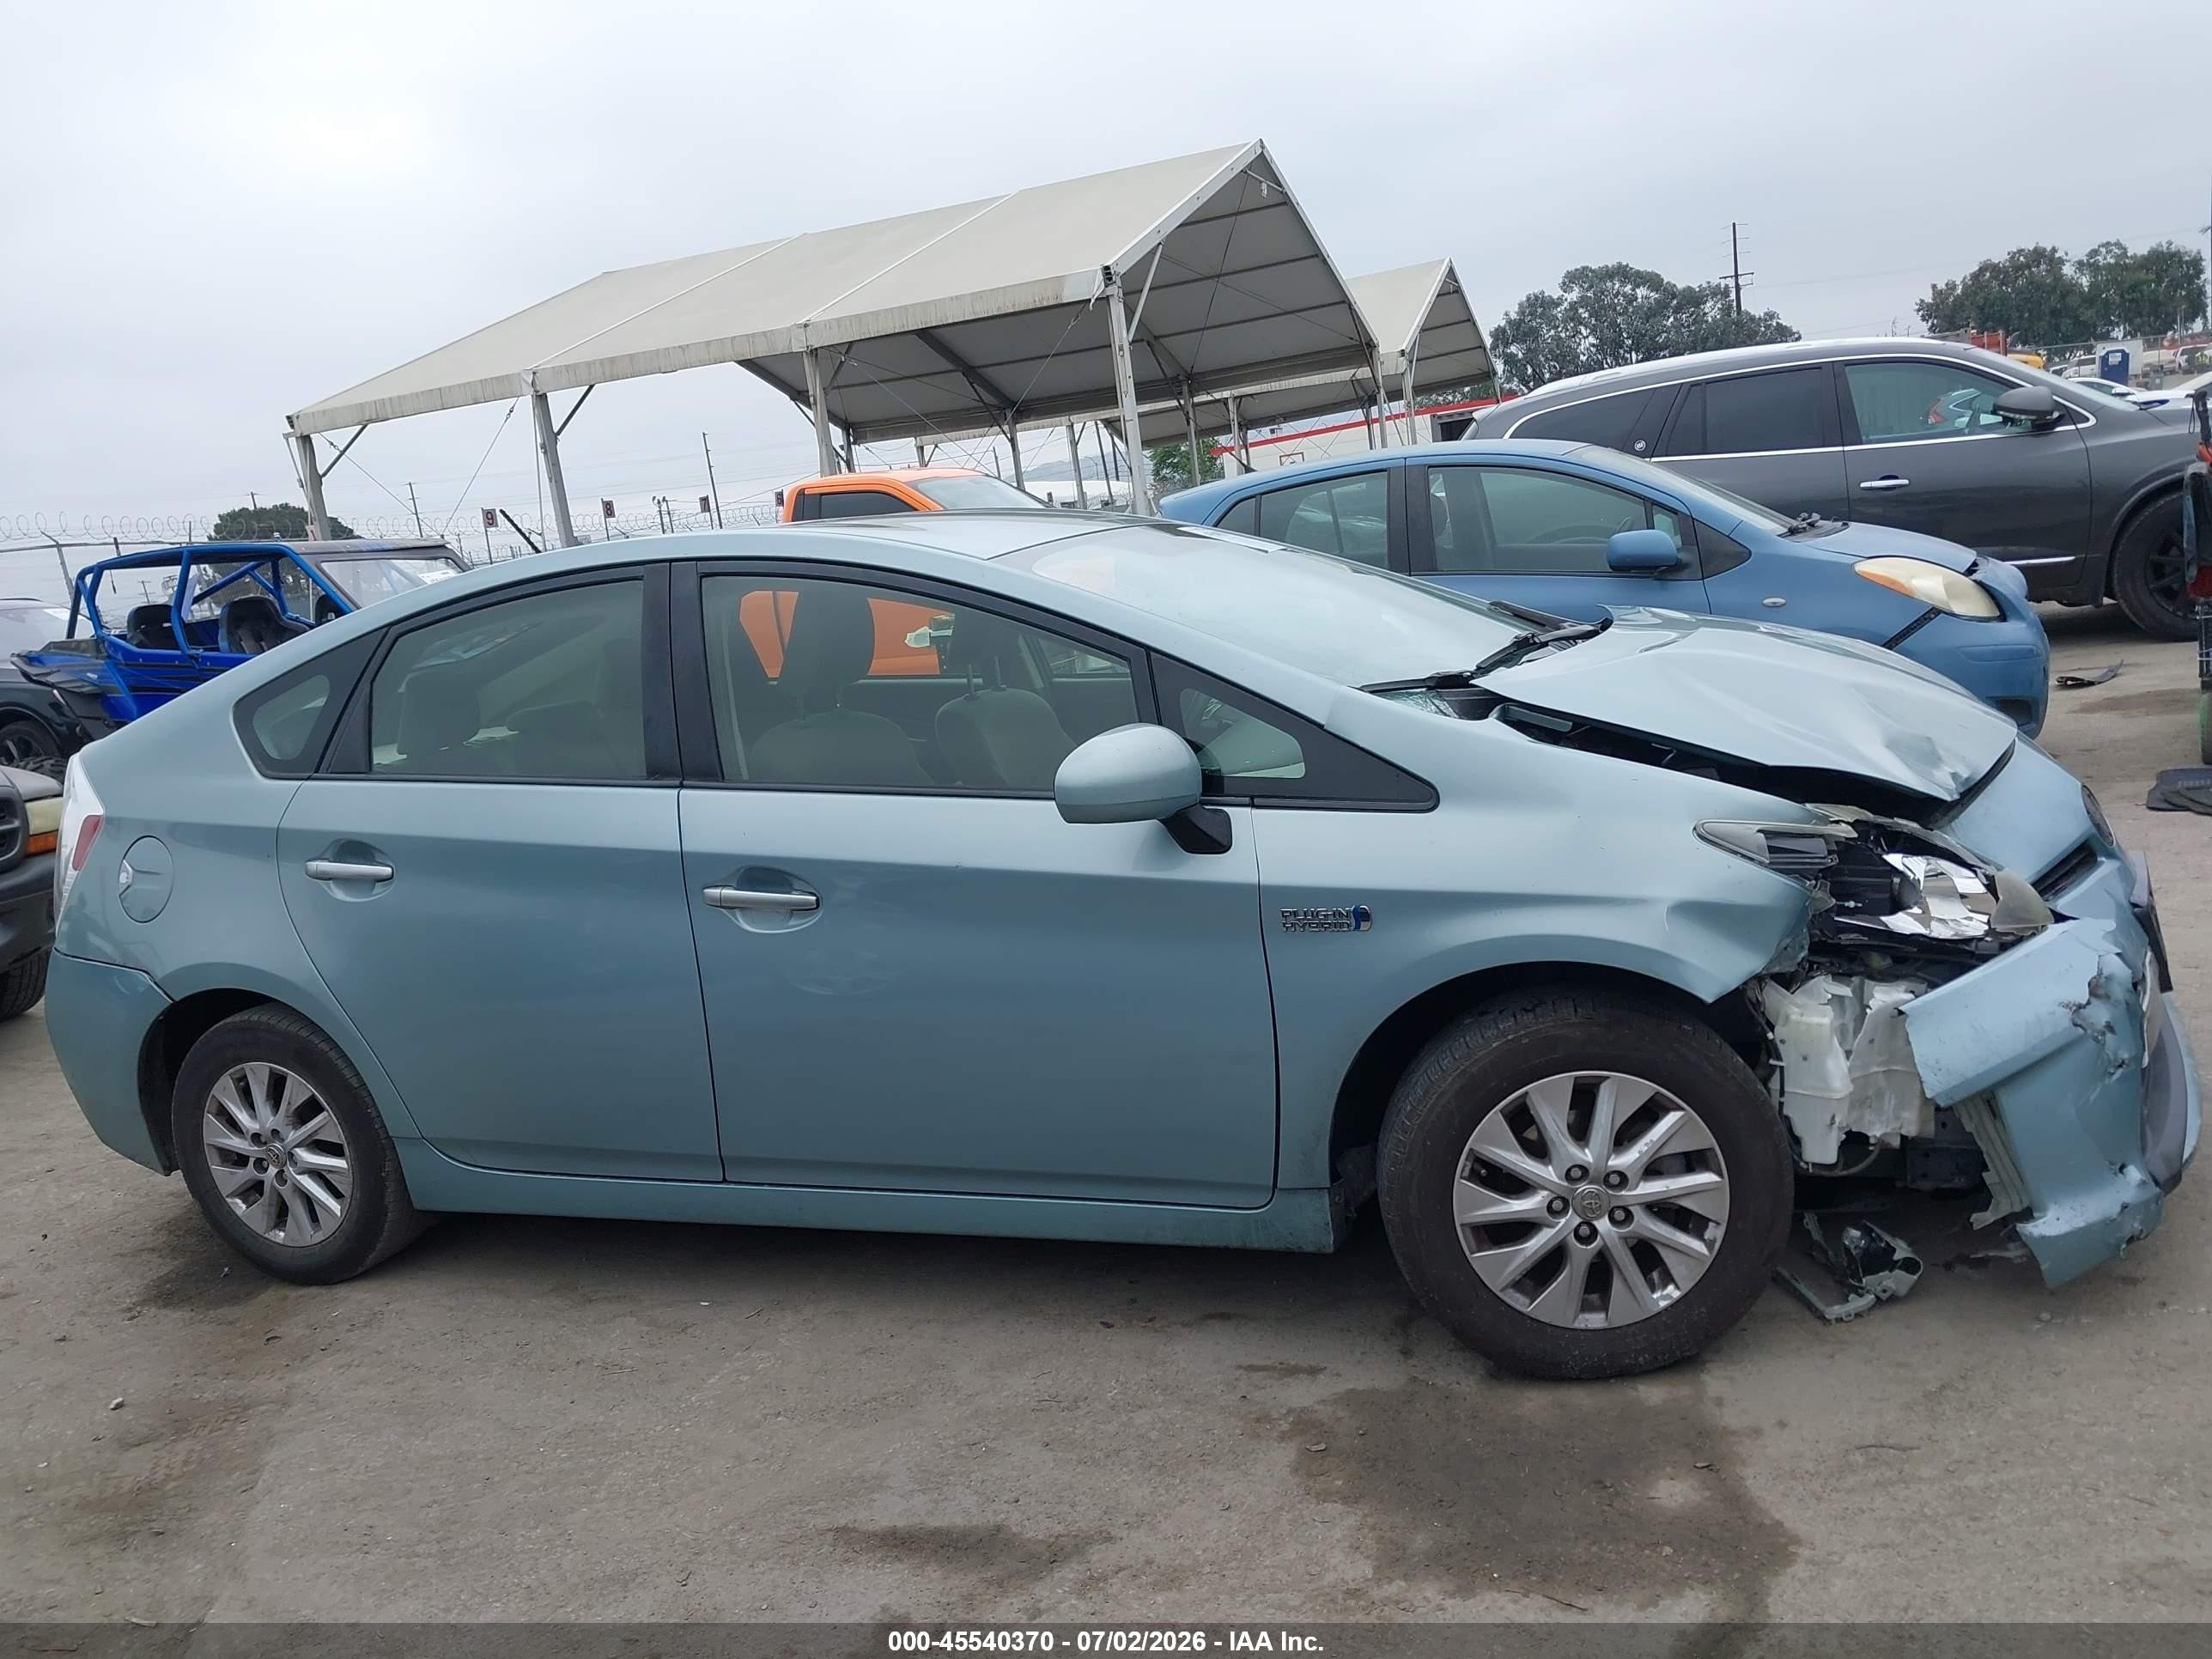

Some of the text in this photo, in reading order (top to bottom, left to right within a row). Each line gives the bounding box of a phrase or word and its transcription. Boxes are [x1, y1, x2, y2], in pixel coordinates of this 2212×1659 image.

[701, 498, 707, 510] 7
[776, 493, 782, 505] 6
[605, 503, 612, 516] 8
[485, 511, 495, 526] 9
[1281, 921, 1352, 933] HYBRID
